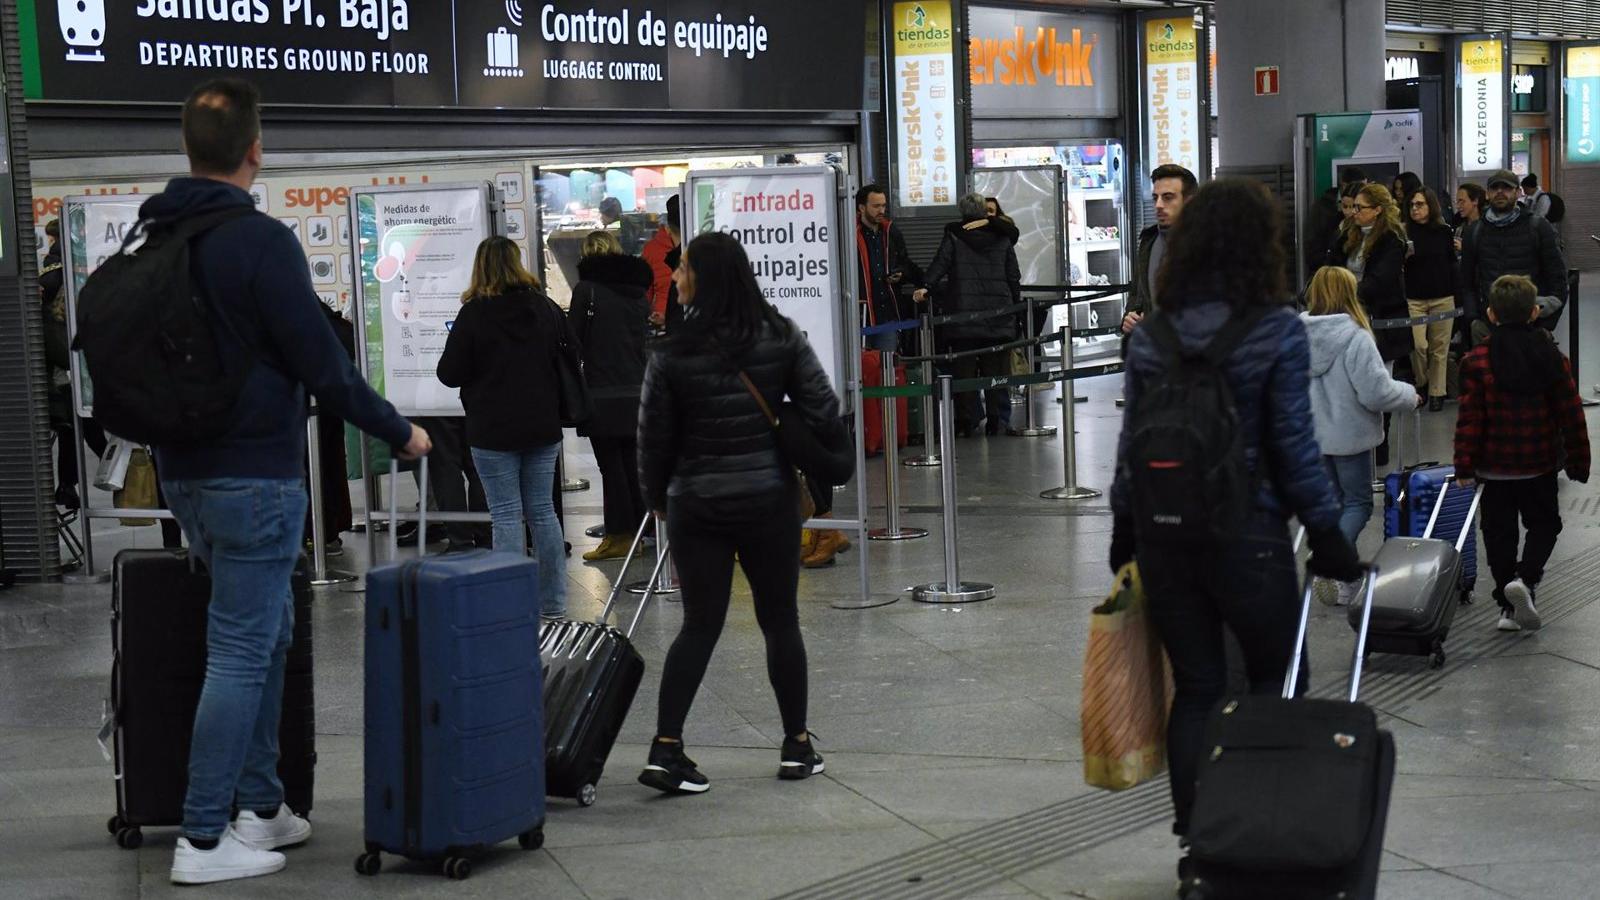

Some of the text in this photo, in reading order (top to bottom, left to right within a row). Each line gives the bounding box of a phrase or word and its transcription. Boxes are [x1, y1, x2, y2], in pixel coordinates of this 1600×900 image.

[339, 0, 409, 41] Baja
[541, 4, 768, 59] Control de equipaje
[897, 28, 950, 41] tiendas
[139, 42, 429, 74] DEPARTURES GROUND FLOOR
[1149, 40, 1195, 53] tiendas
[543, 59, 663, 82] LUGGAGE CONTROL
[1477, 78, 1488, 165] CALZEDONIA
[384, 204, 430, 214] Medidas de
[732, 189, 814, 212] Entrada
[384, 215, 457, 226] ahorro energético
[720, 221, 828, 245] ontrol de
[778, 286, 822, 298] CONTROL
